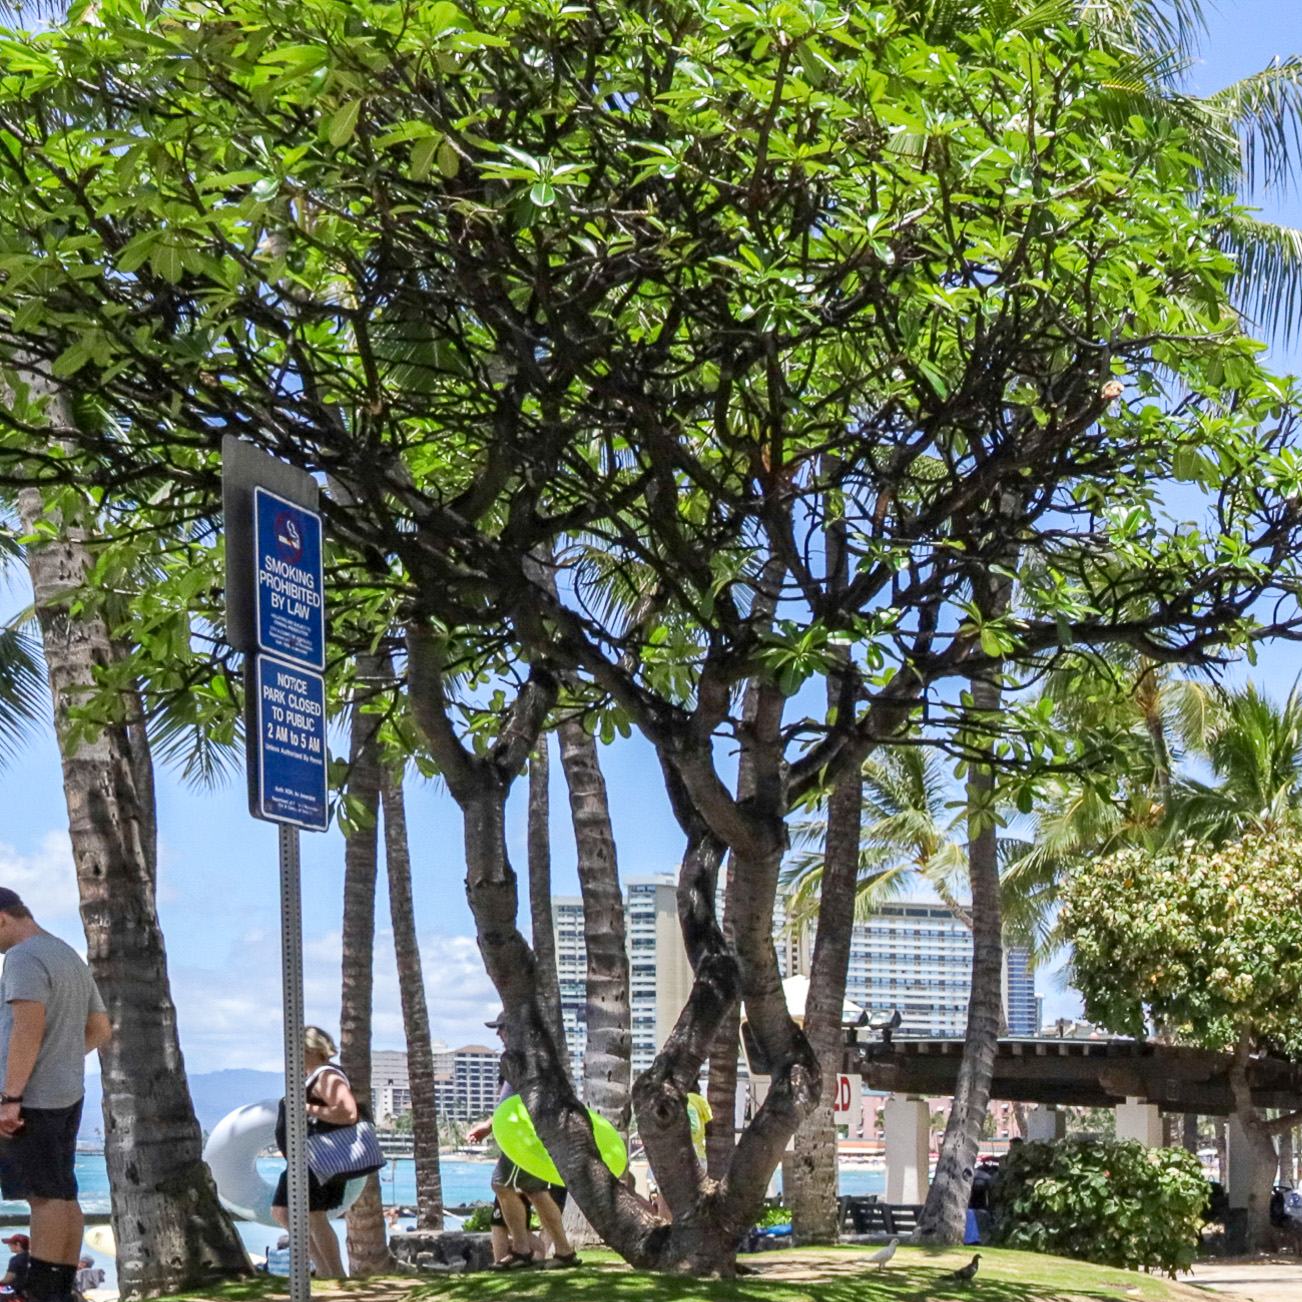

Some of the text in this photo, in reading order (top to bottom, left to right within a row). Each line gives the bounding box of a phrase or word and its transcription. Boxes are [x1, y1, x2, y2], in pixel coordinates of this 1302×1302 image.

[265, 555, 314, 589] SMOKING
[260, 570, 320, 608] PROHIBITED
[271, 591, 310, 620] BY LAW
[277, 672, 308, 695] NOTICE
[263, 684, 321, 717] PARK CLOSED
[271, 705, 315, 732] TO PUBLIC
[267, 722, 320, 753] 2 AM to 5 AM
